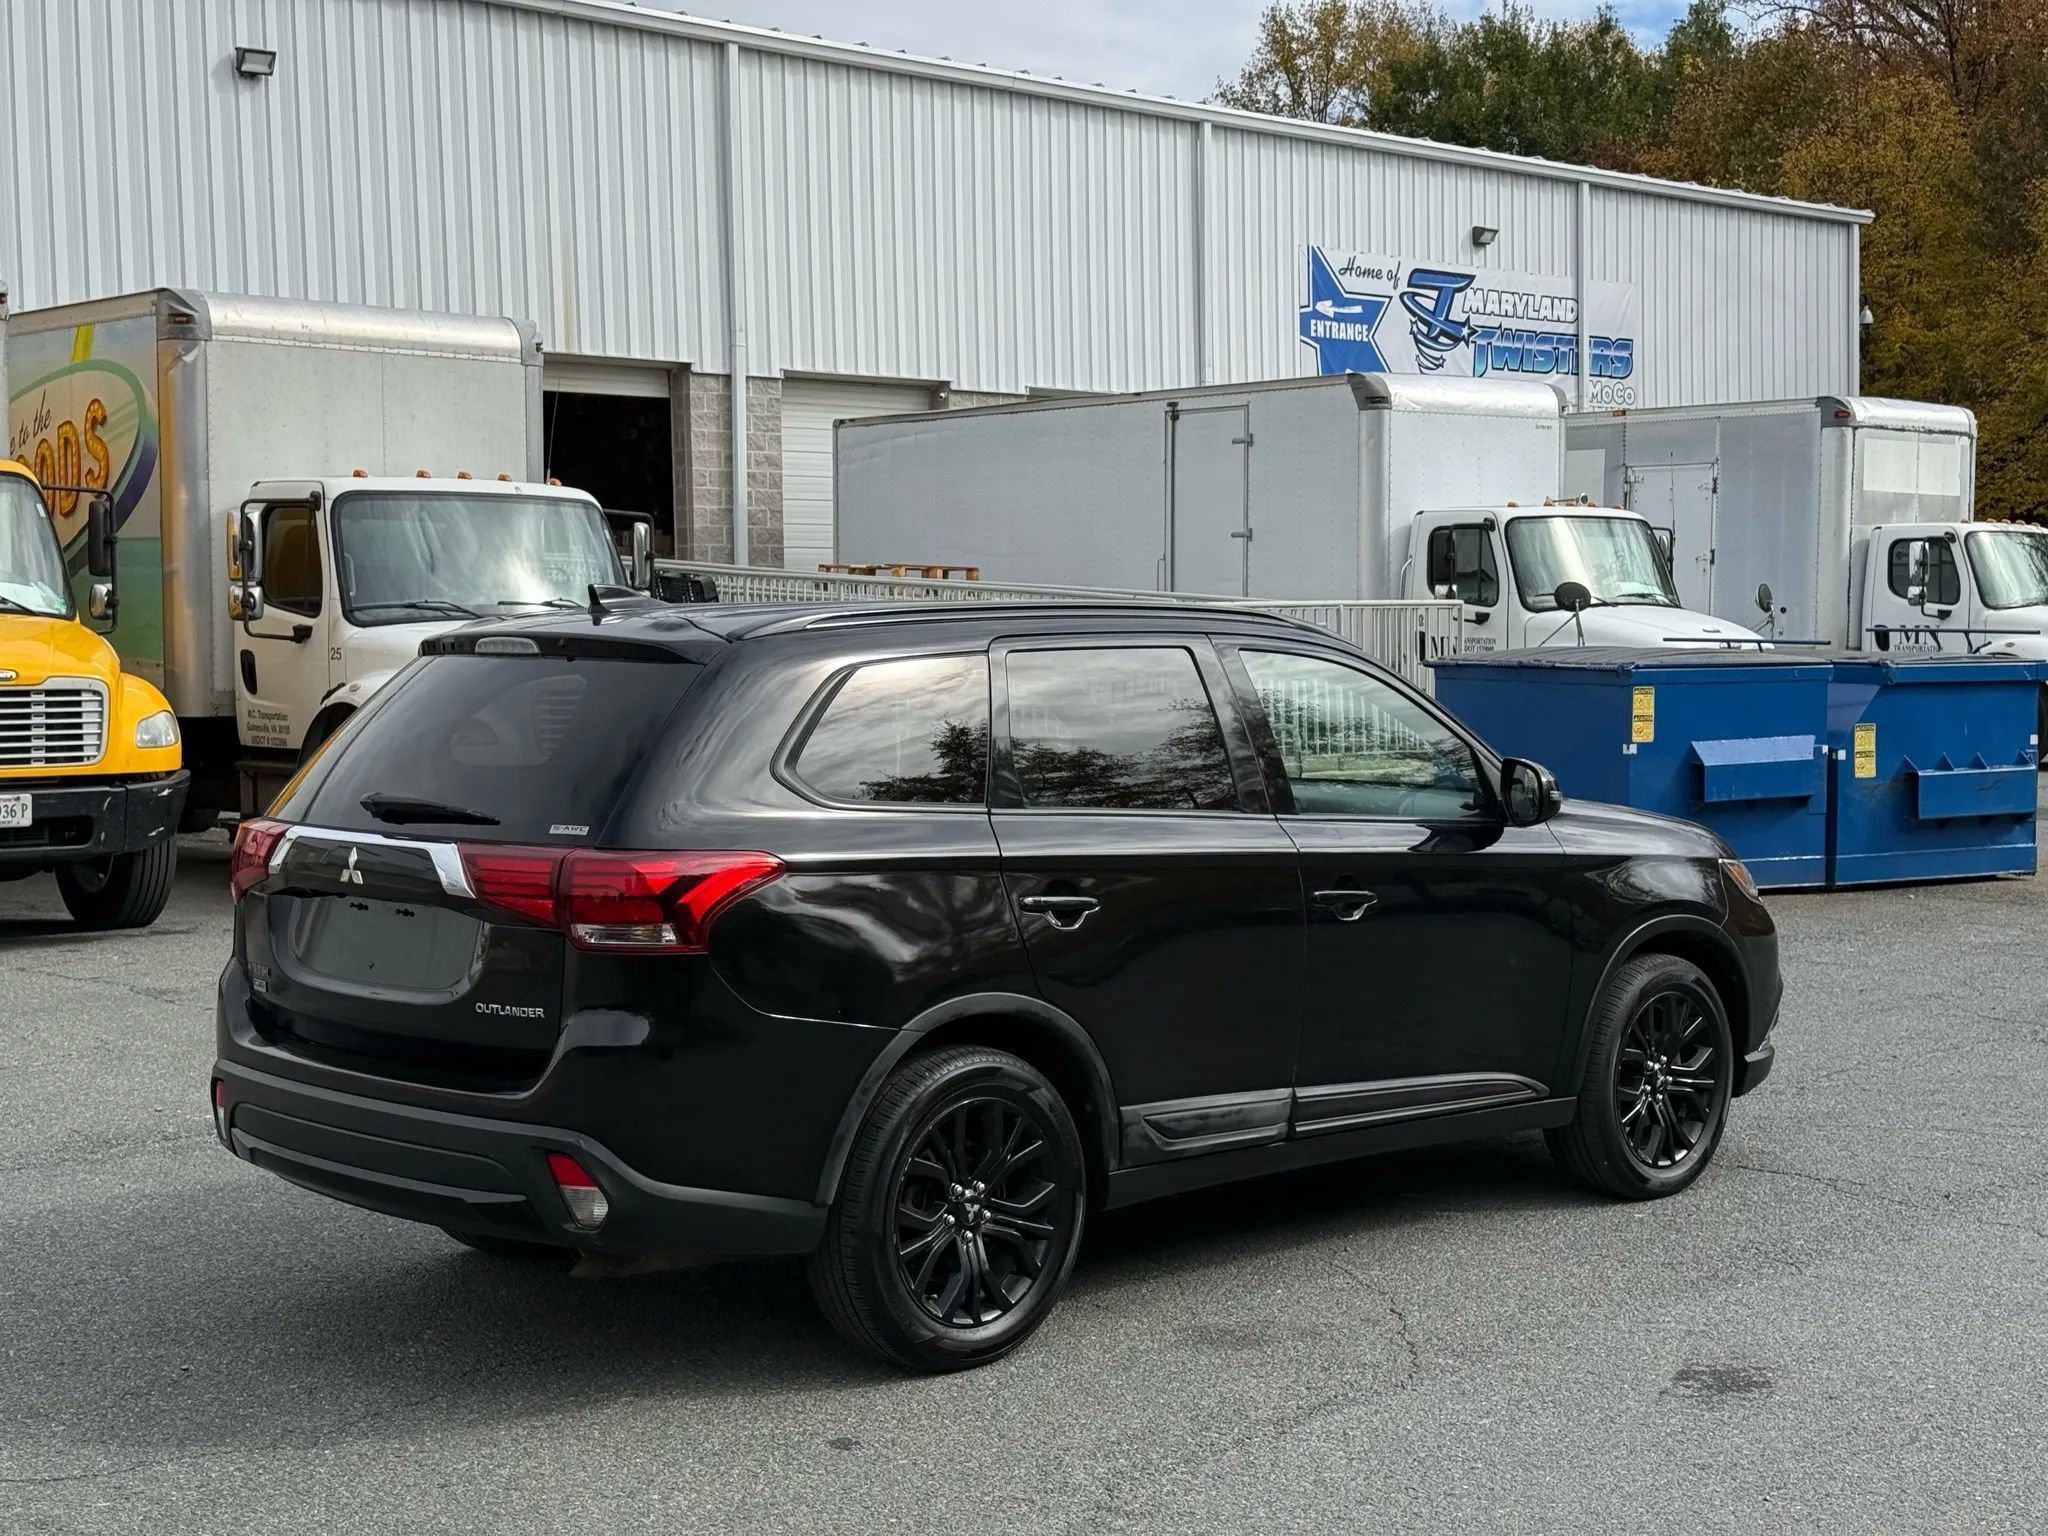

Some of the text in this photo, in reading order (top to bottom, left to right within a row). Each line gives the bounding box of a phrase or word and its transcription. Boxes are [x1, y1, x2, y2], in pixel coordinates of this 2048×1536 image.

[1338, 255, 1401, 290] Home of
[1462, 288, 1579, 324] MARYLAND
[1310, 319, 1369, 342] ENTRANCE
[1589, 379, 1636, 406] MoCo
[19, 420, 30, 449] to
[33, 389, 52, 438] the
[16, 398, 110, 518] ODS
[330, 647, 342, 660] 25
[0, 802, 28, 819] 36 P
[475, 1002, 545, 1018] OUTLANDER
